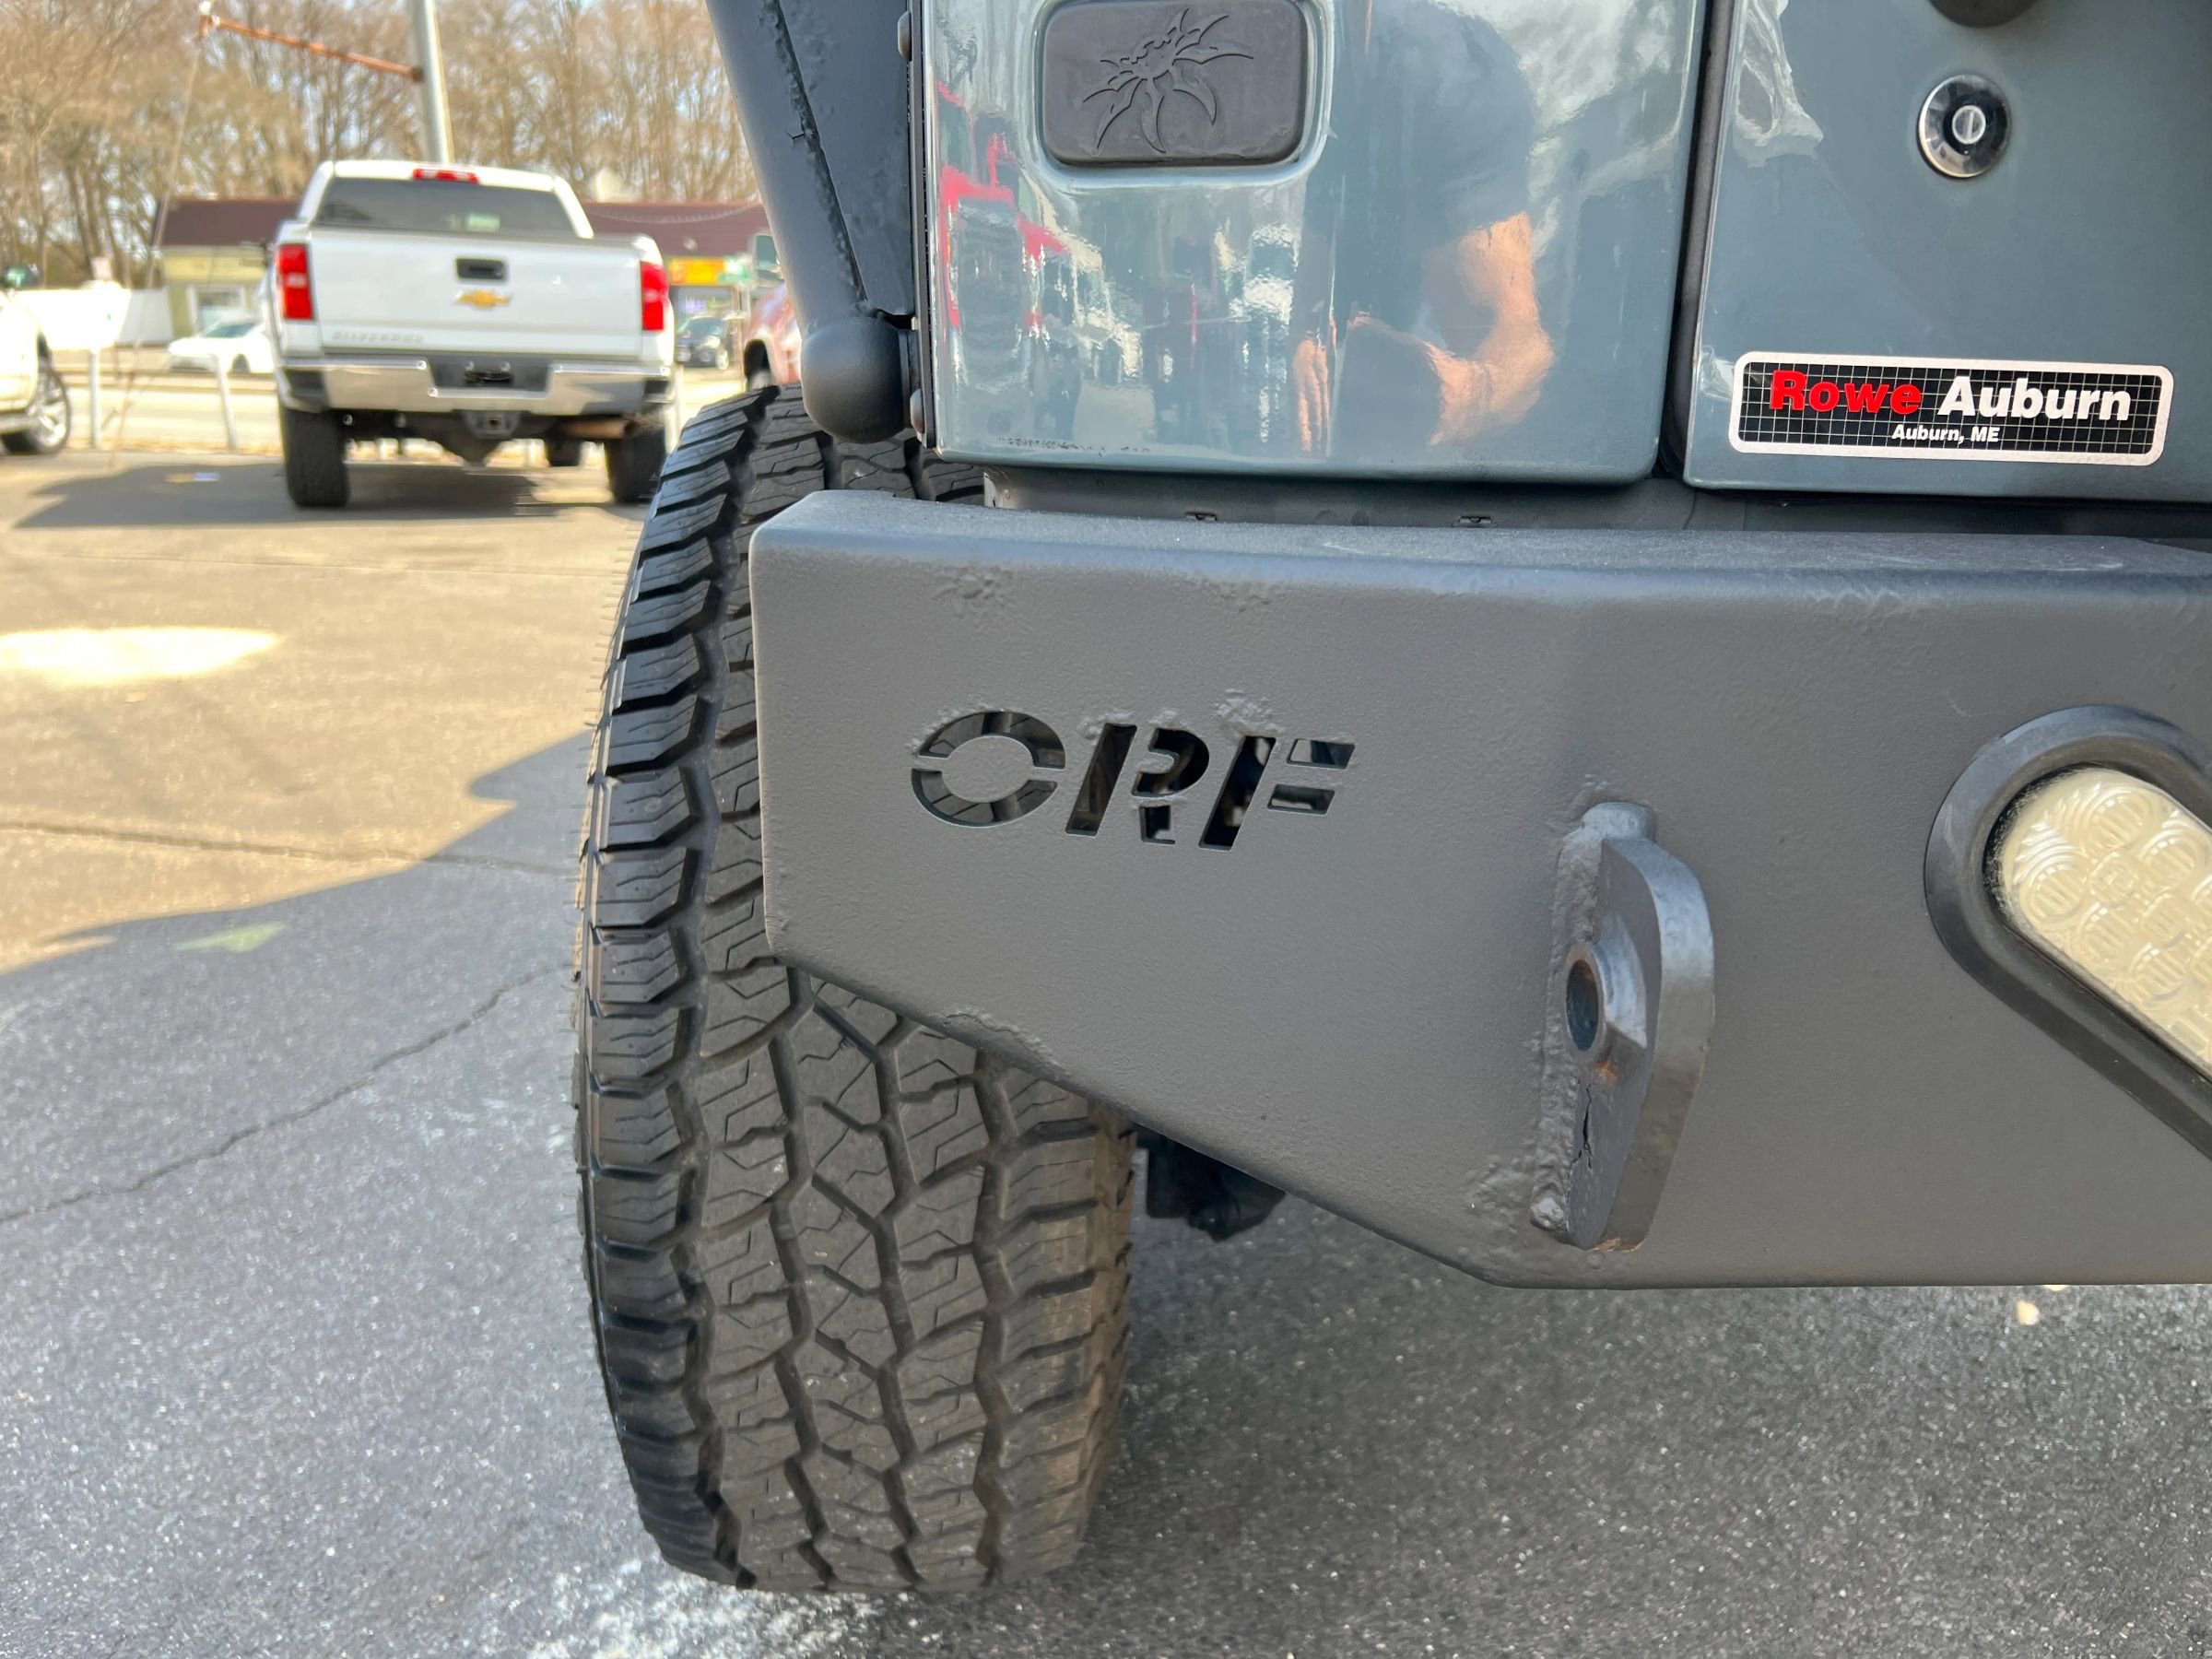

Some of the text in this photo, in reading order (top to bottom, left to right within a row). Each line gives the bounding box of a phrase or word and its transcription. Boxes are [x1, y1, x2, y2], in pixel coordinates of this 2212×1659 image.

[1770, 370, 2131, 421] Rowe Auburn
[1892, 424, 1999, 444] Auburn, ME
[912, 710, 1355, 851] ORF
